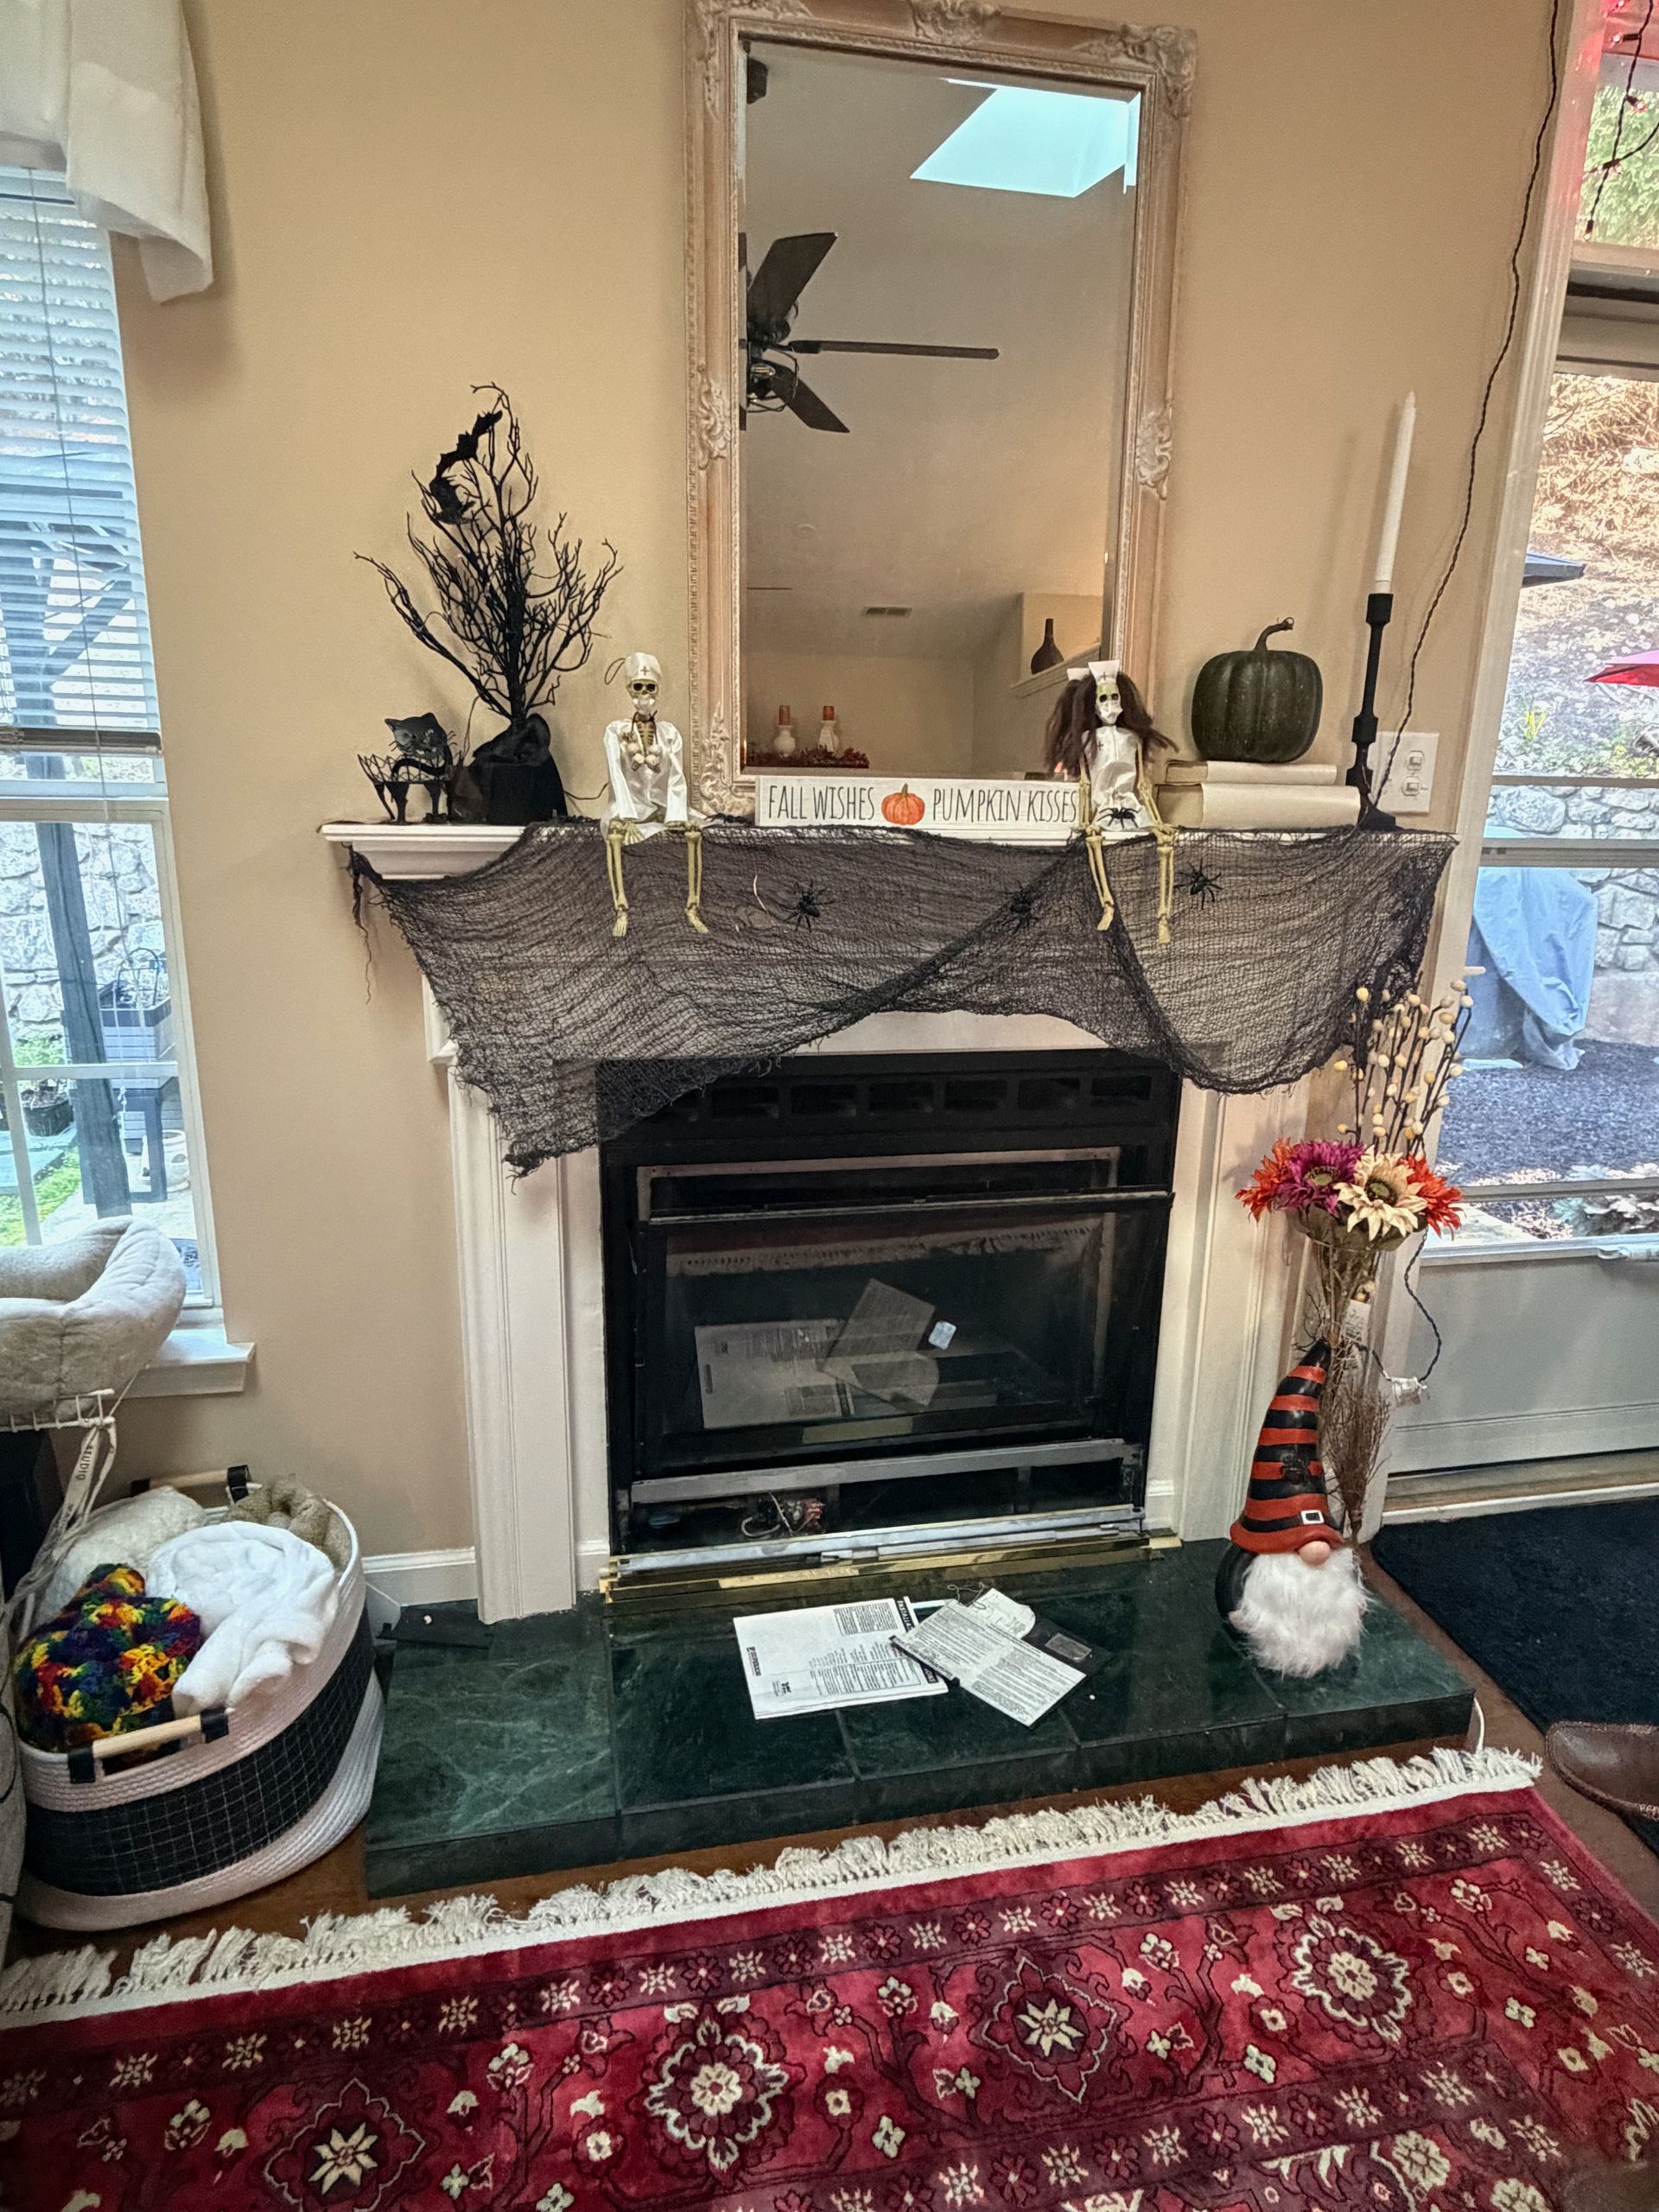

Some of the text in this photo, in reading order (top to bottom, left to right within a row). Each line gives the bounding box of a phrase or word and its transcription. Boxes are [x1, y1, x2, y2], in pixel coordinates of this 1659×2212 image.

[768, 785, 1077, 823] FALL WISHES PUMPKIN KISSES
